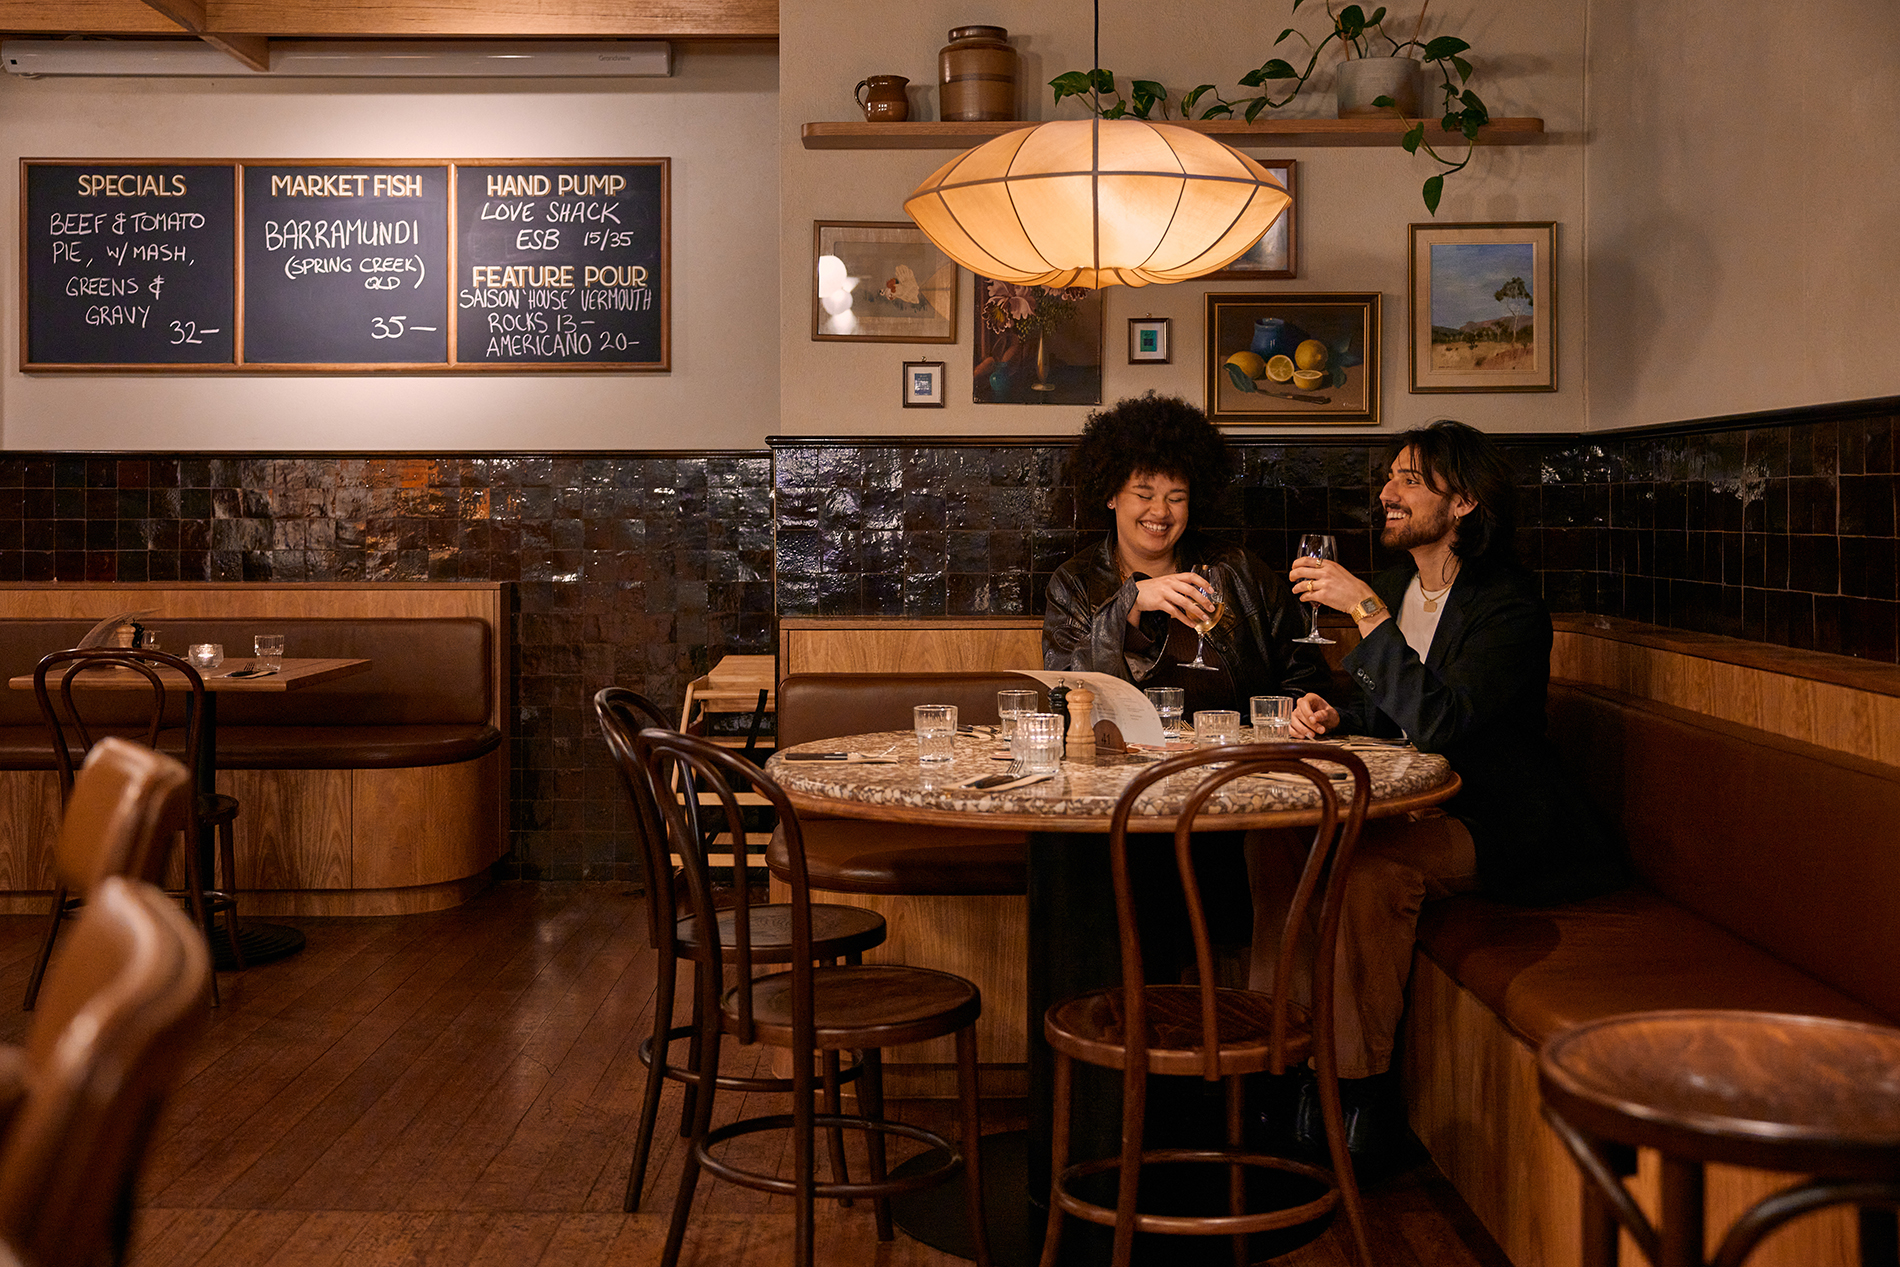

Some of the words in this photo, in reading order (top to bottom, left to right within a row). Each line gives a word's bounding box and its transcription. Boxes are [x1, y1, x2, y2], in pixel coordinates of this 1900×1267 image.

[77, 174, 188, 197] SPECIALS
[271, 174, 370, 198] MARKET
[373, 174, 423, 198] FISH
[487, 174, 552, 198] HAND
[558, 174, 627, 198] PUMP
[50, 212, 108, 236] BEEF
[111, 211, 127, 235] &
[130, 211, 206, 233] TOMATO
[481, 201, 535, 222] LOVE
[546, 201, 621, 224] SHACK
[265, 218, 419, 251] BARRAMUNDI
[515, 228, 561, 250] ESB
[583, 228, 634, 251] 15/35
[52, 240, 94, 268] PIE,
[133, 243, 196, 266] MASH,
[284, 255, 353, 280] (SPRING
[472, 265, 575, 289] FEATURE
[584, 265, 649, 288] POUR
[65, 275, 140, 297] GREENS
[148, 274, 166, 301] &
[459, 288, 520, 310] SAISON
[580, 287, 652, 312] VERMOUTH
[85, 305, 151, 329] GRAVY
[487, 311, 549, 334] ROCKS
[485, 333, 592, 358] AMERICANO
